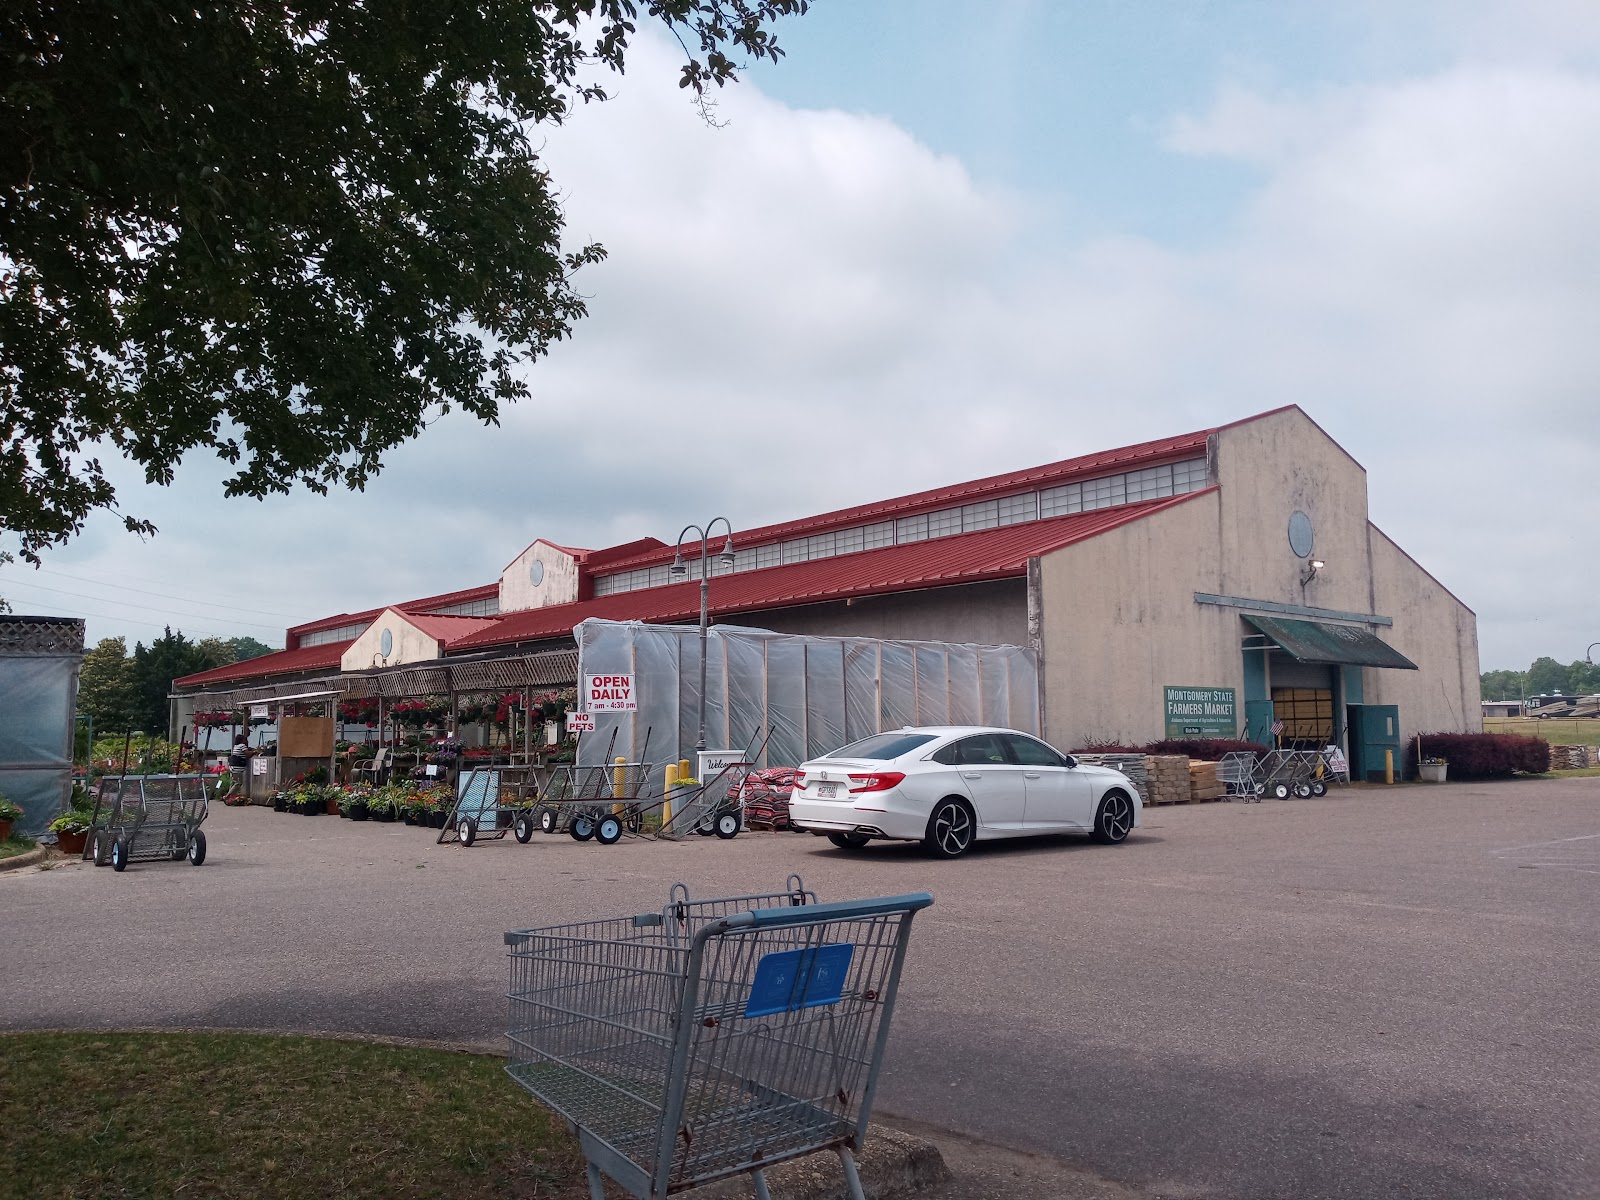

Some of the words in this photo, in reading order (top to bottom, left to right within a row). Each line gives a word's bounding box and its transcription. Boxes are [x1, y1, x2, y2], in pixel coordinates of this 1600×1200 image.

[592, 676, 630, 687] OPEN
[591, 689, 631, 700] DAILY
[1167, 689, 1211, 701] MONTGOMERY
[1213, 690, 1233, 701] STATE
[610, 701, 625, 709] 4:30
[625, 702, 636, 710] pm
[1168, 702, 1203, 715] FARMERS
[1204, 702, 1233, 715] MARKET
[569, 723, 594, 731] PETS
